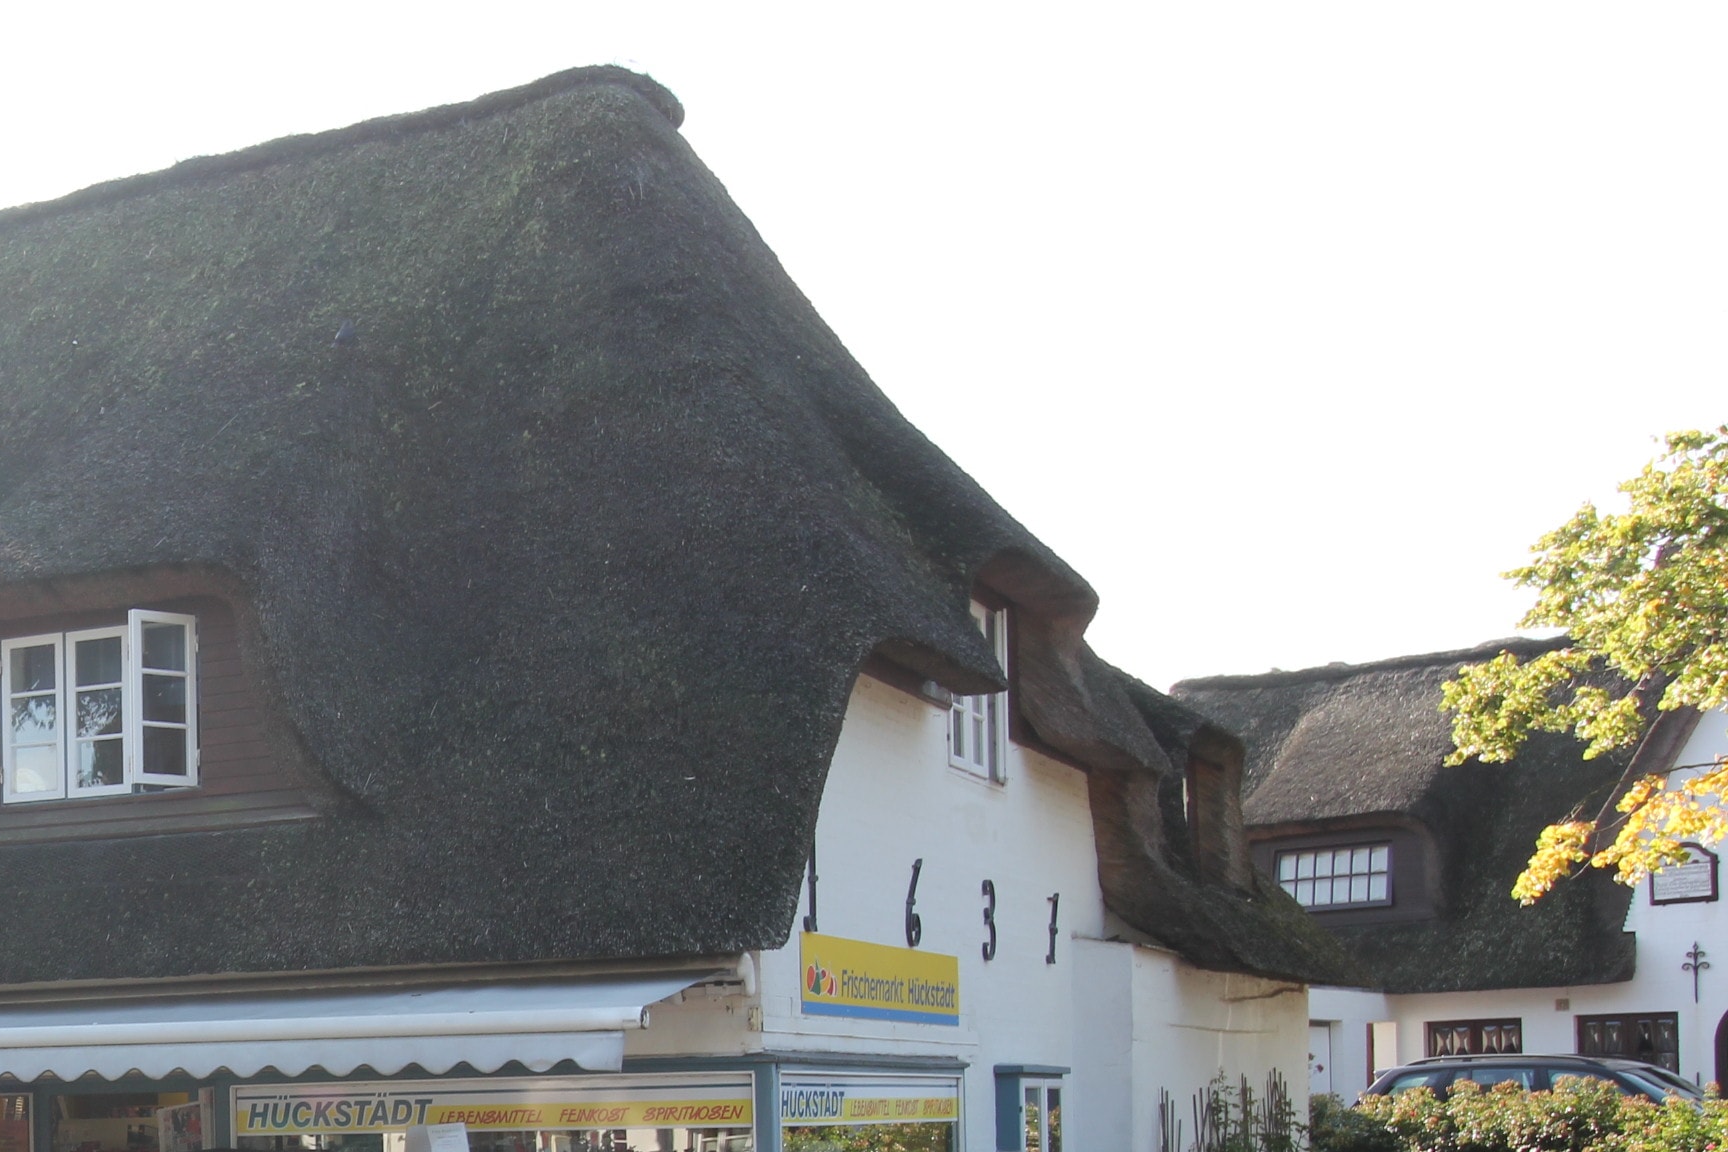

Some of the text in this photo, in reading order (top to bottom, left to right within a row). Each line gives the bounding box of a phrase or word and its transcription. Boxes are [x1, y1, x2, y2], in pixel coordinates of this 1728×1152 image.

[841, 969, 955, 1008] Frischemarkt Hückstädt
[247, 1093, 744, 1129] HÜCKSTÄDT LEBENSMITTEL FEINKOST SPIRITUOSEN
[780, 1083, 845, 1118] HÜCKSTÄDT
